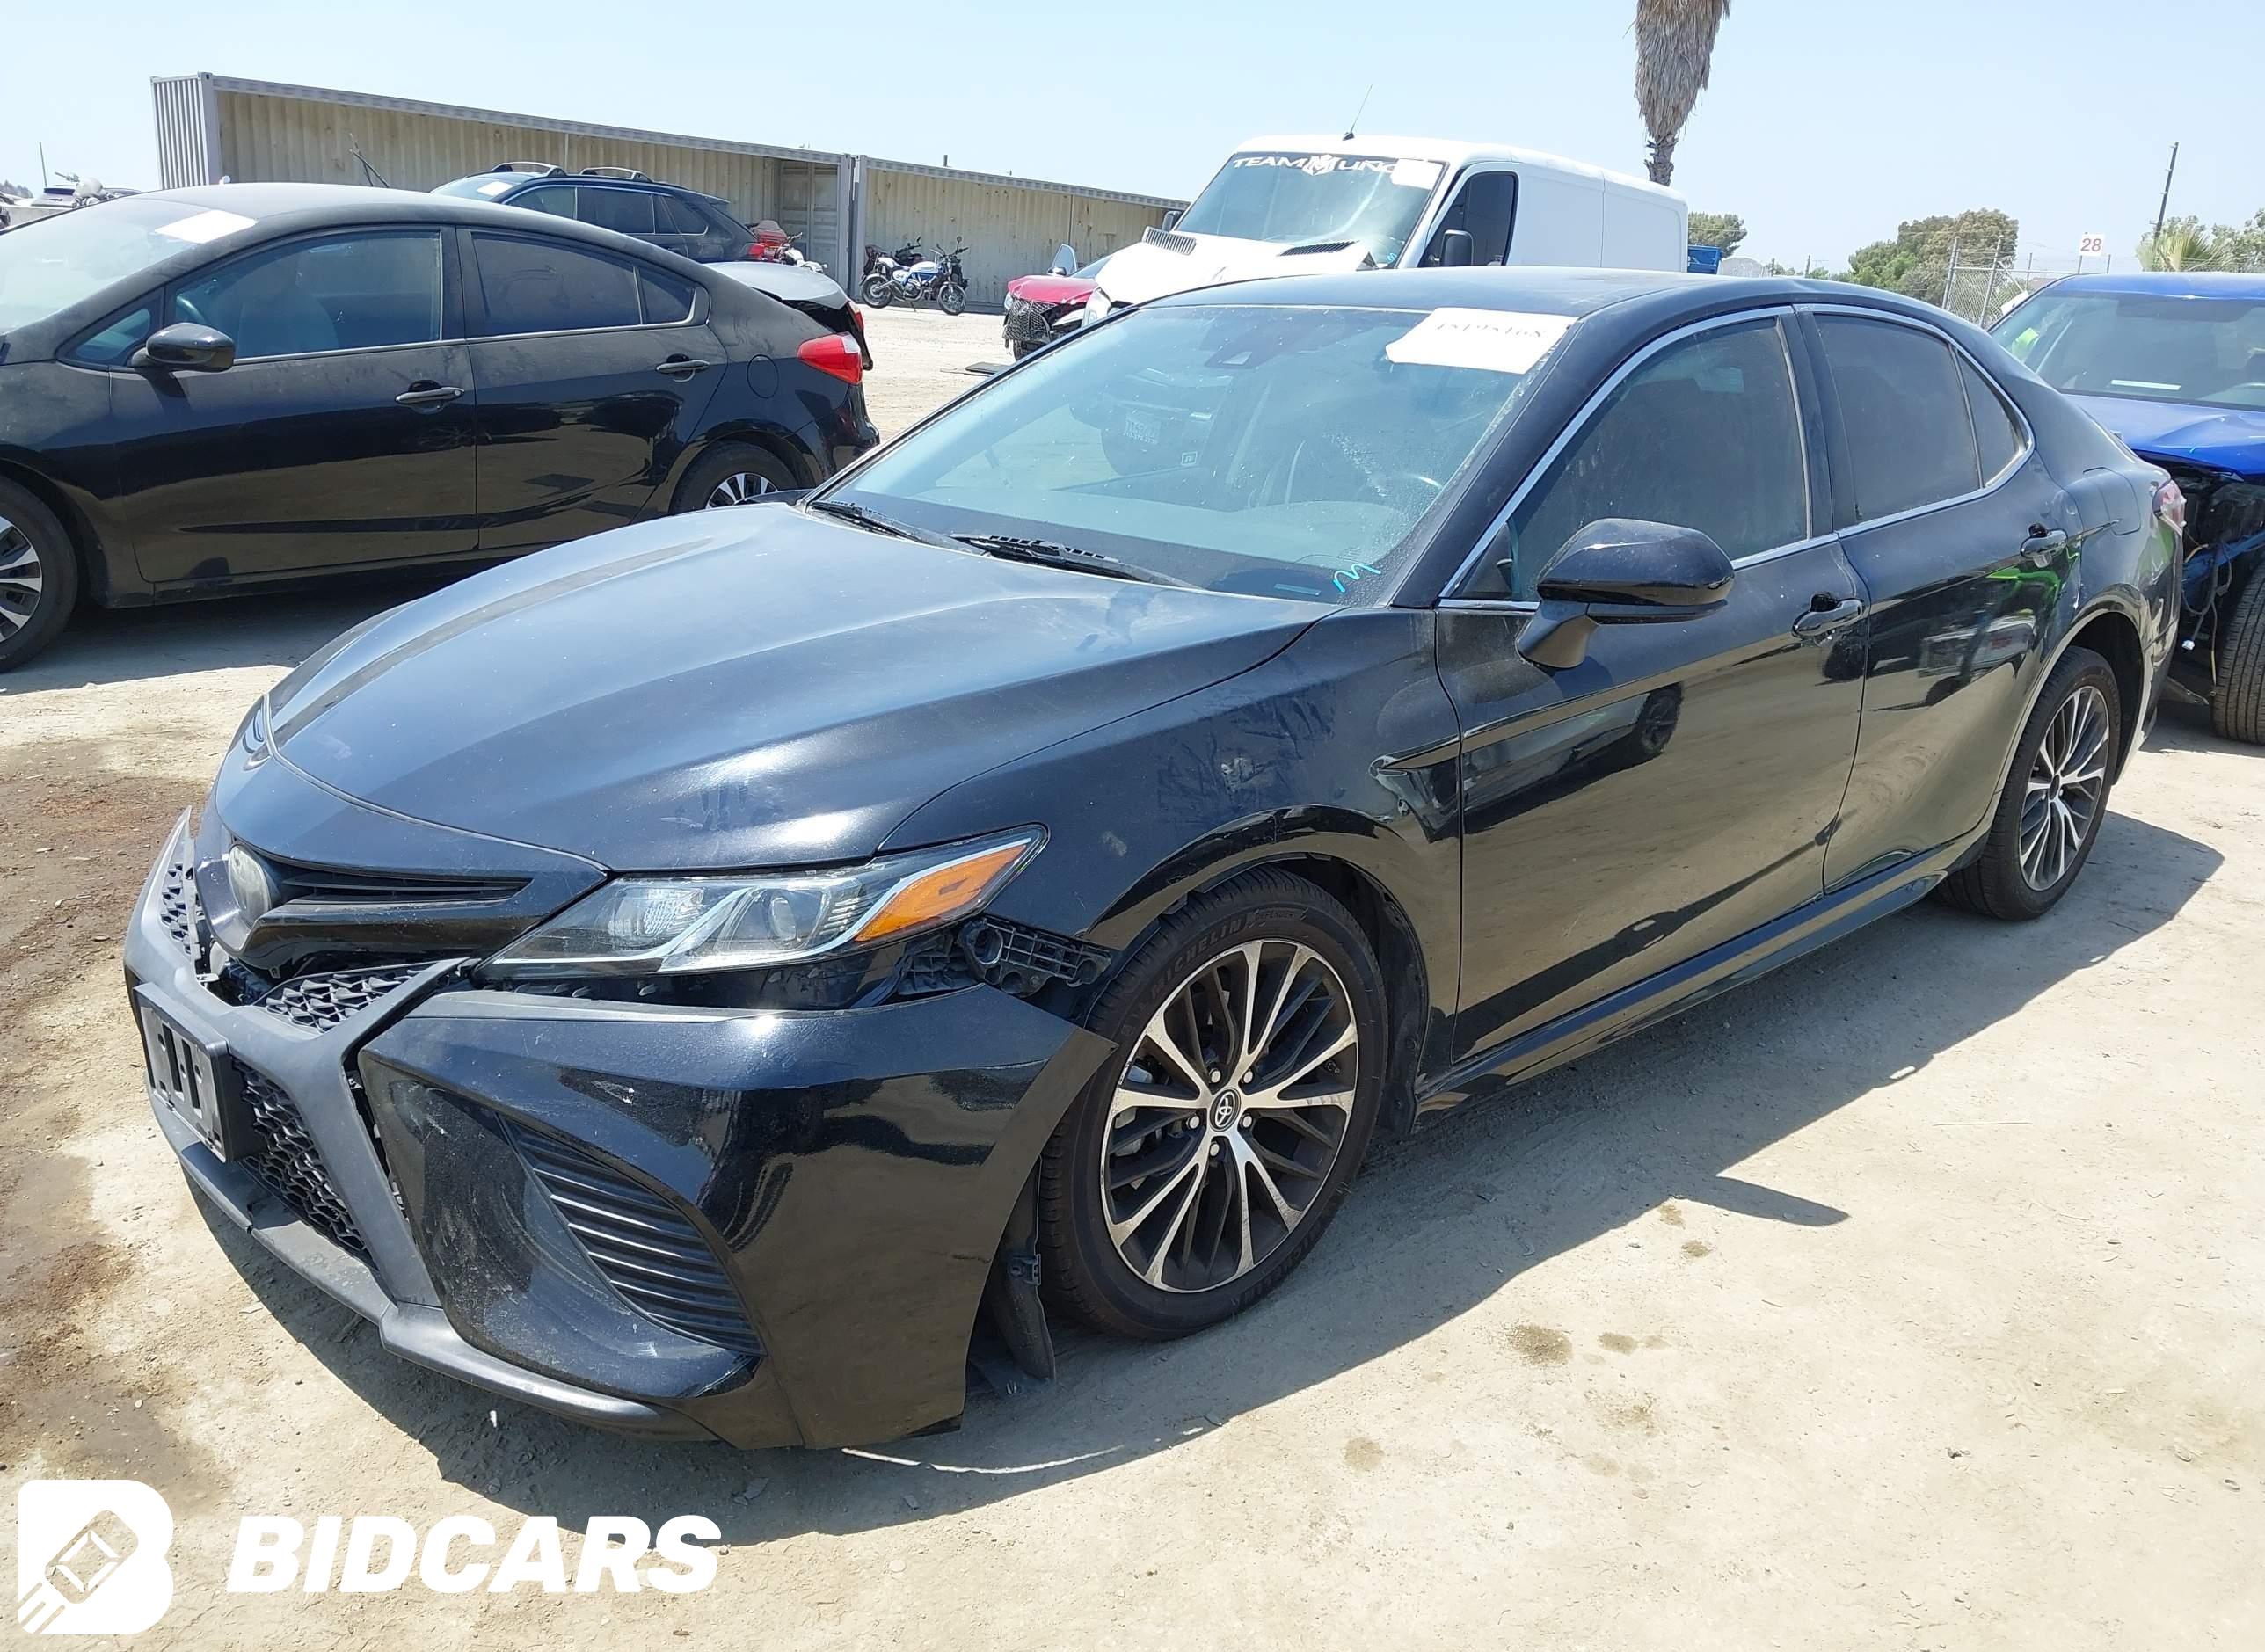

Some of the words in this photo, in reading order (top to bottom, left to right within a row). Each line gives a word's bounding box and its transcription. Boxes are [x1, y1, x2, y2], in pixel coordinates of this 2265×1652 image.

[1233, 156, 1309, 168] TEAM
[2080, 237, 2102, 251] 28
[1152, 918, 1244, 1000] MICHELIN
